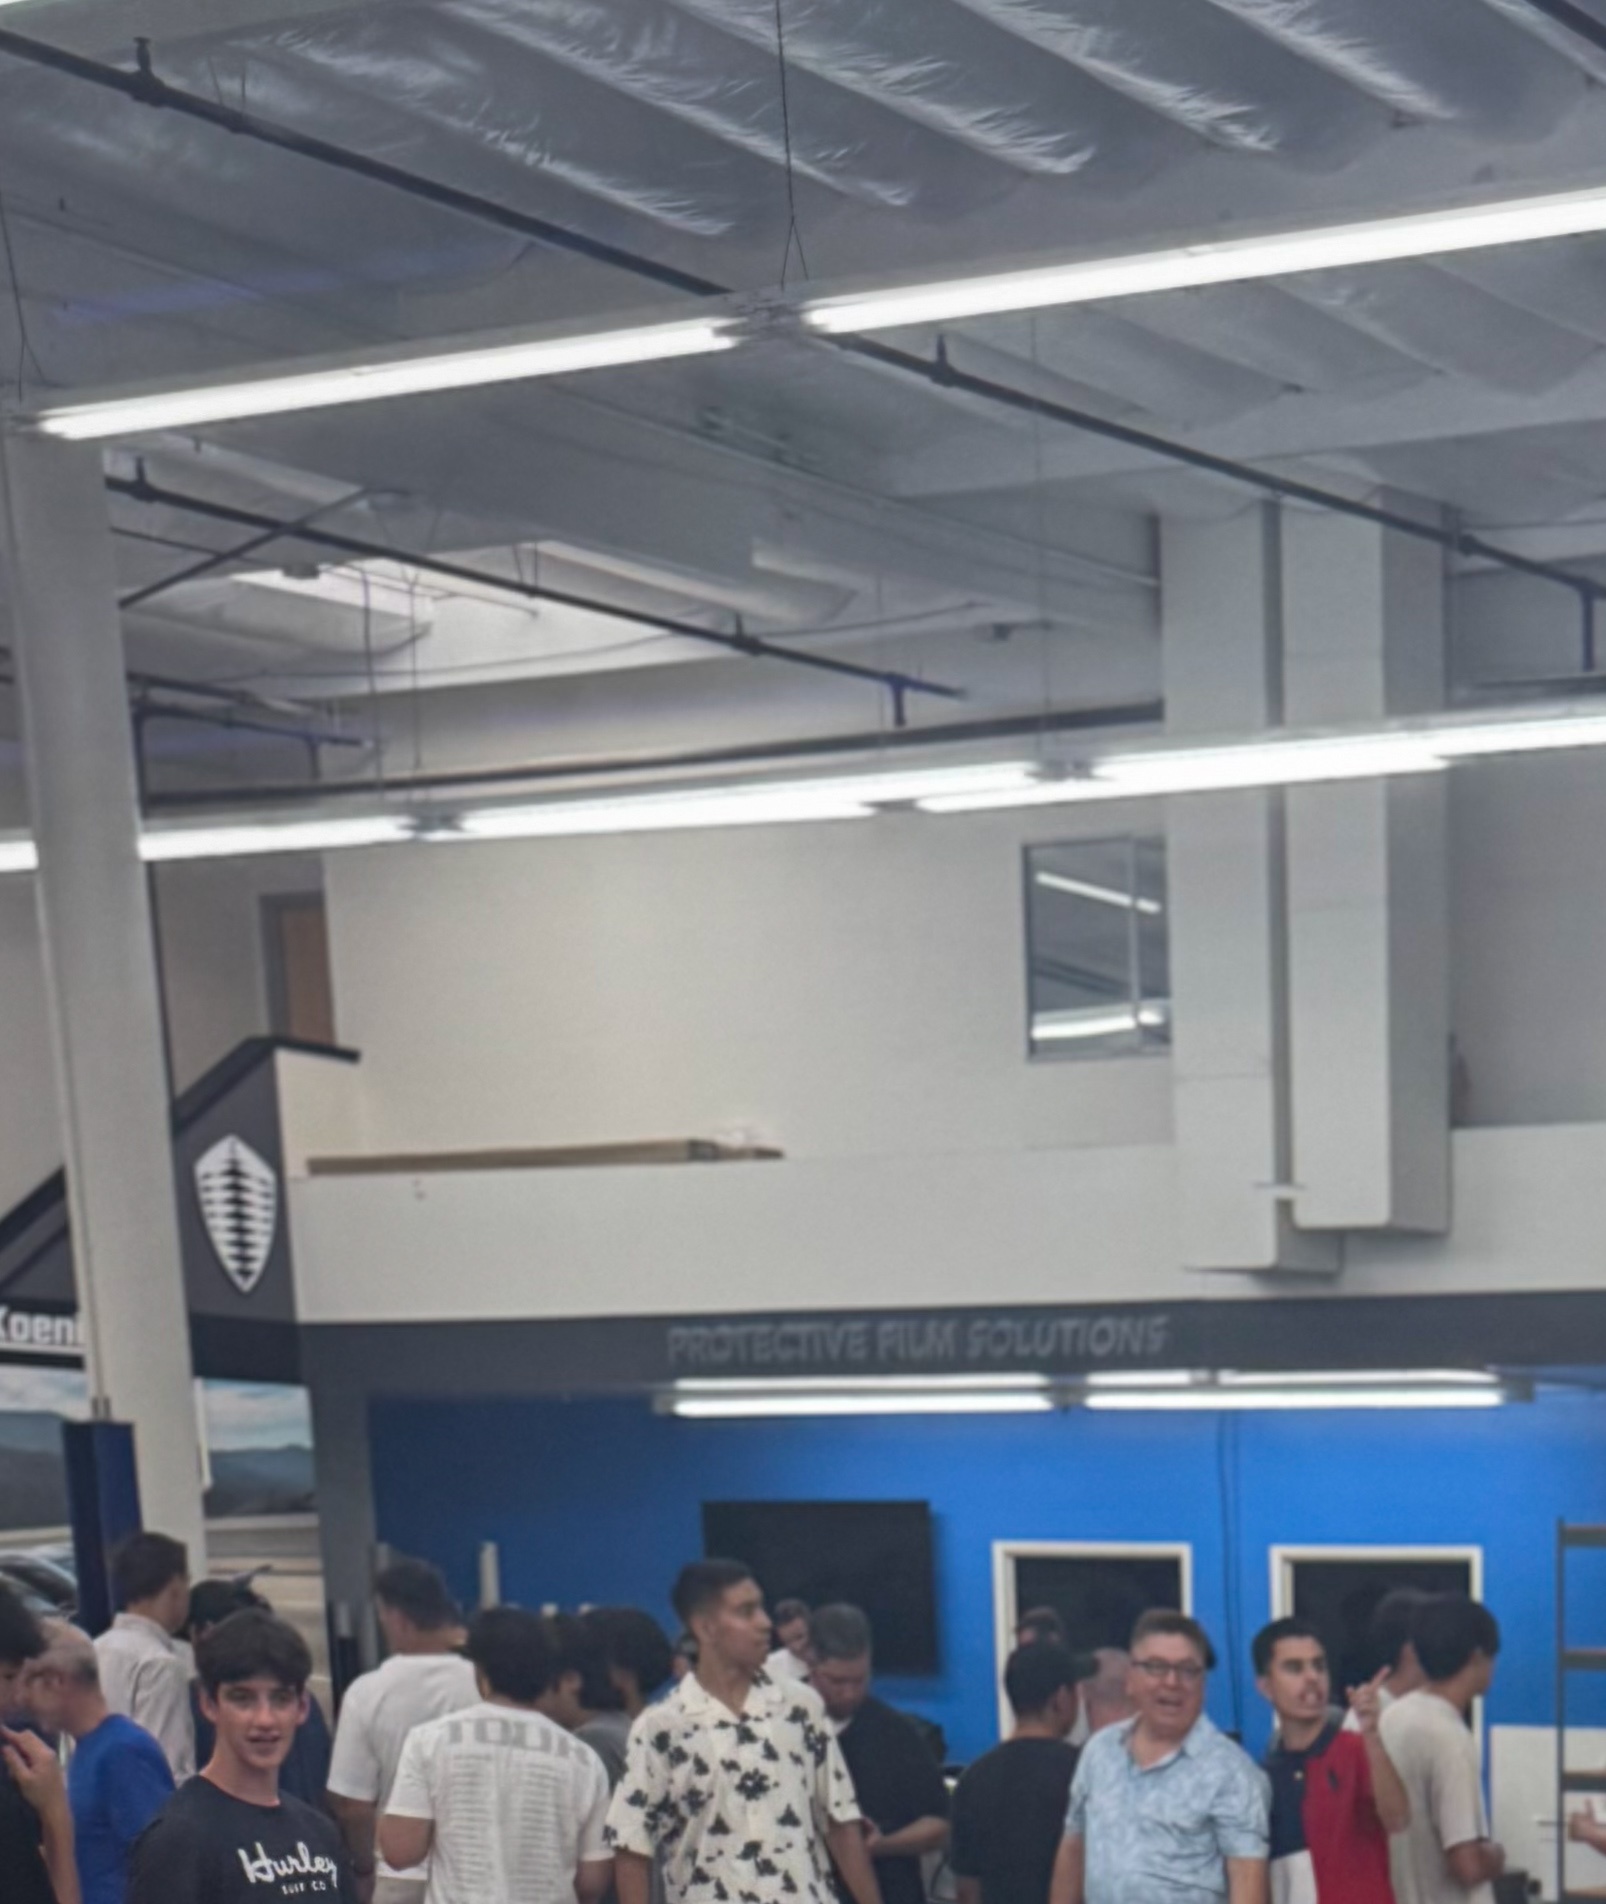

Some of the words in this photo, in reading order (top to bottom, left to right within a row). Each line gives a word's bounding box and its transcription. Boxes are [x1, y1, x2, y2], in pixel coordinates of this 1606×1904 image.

[667, 1322, 868, 1363] PROTECTIVE
[877, 1320, 957, 1360] FILM
[967, 1315, 1171, 1358] SOLUTIONS
[237, 1841, 338, 1889] Hurley
